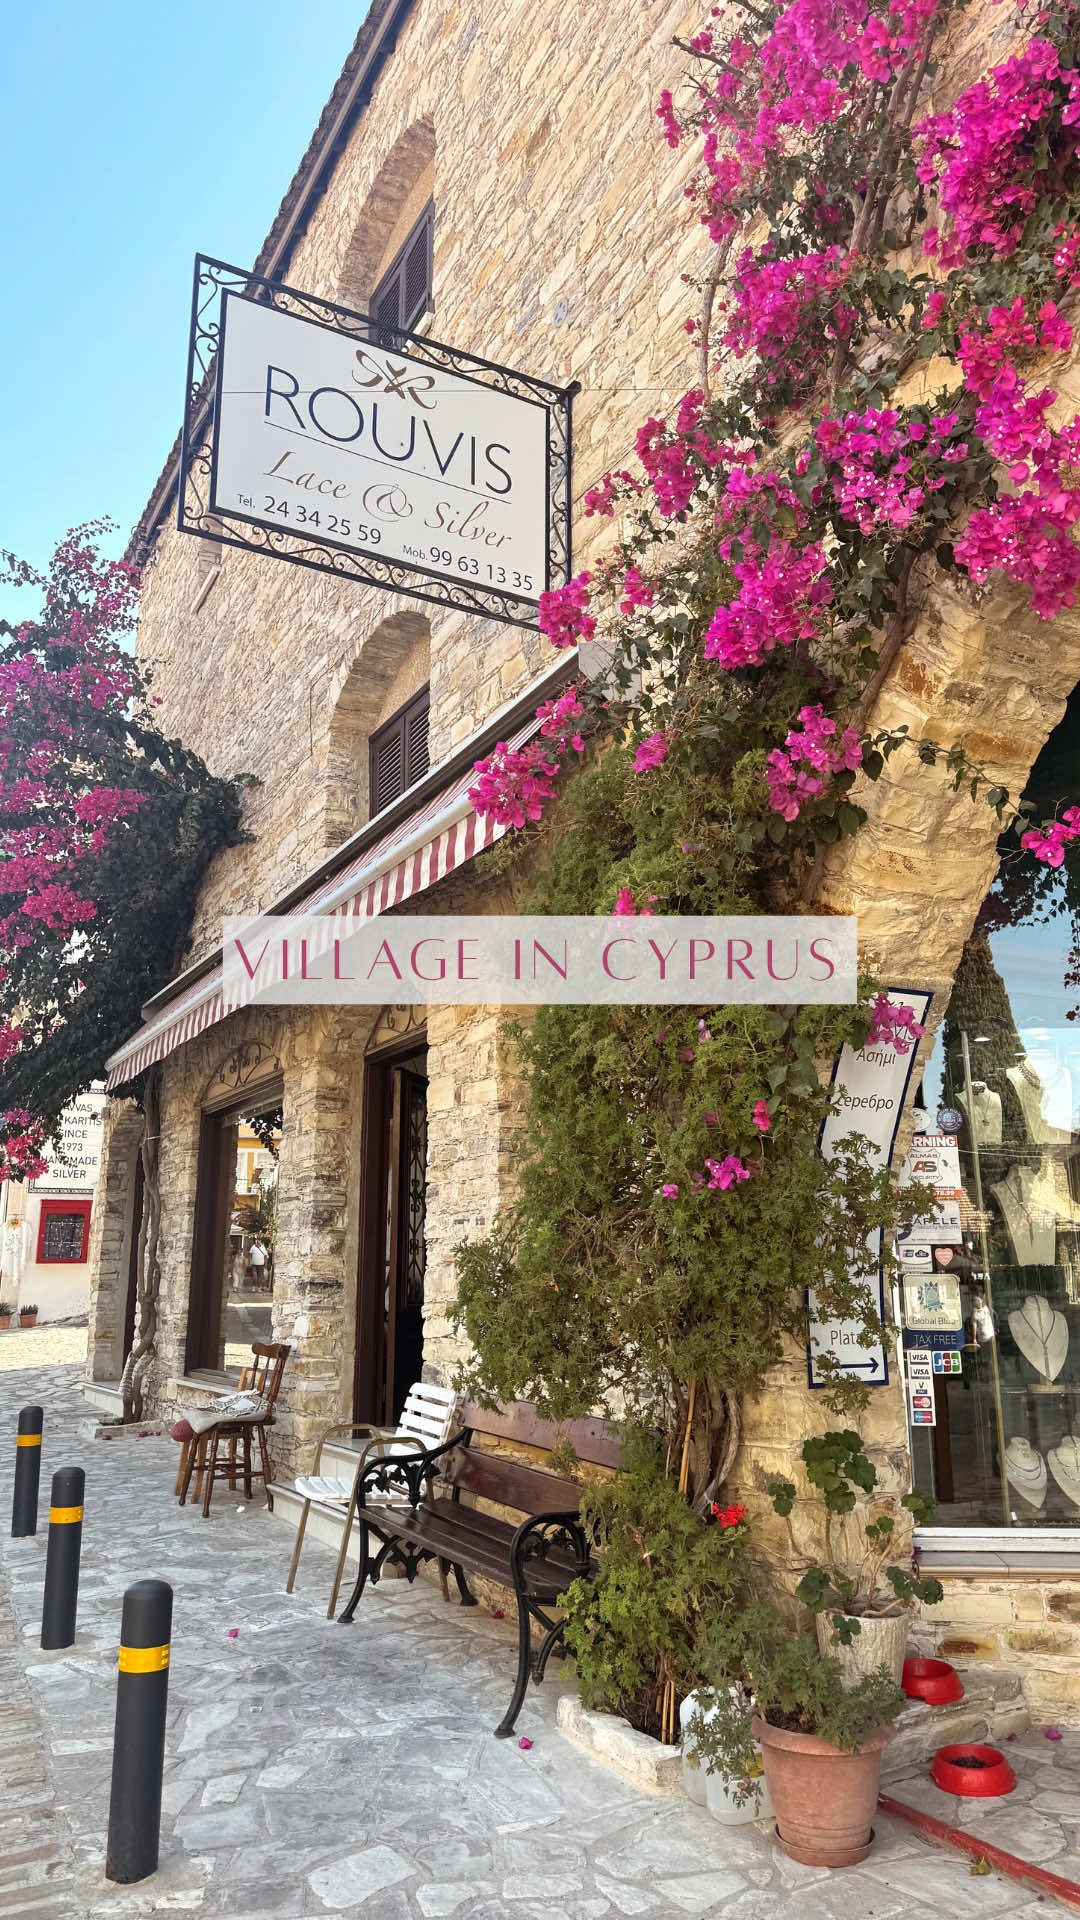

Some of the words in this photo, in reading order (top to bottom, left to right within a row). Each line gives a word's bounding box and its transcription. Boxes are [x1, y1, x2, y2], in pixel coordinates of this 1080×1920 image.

[264, 365, 512, 495] ROUVIS
[263, 450, 351, 499] Lace
[362, 481, 413, 523] &
[423, 501, 512, 548] Silver
[236, 493, 256, 509] Tel.
[263, 495, 290, 518] 24
[296, 505, 321, 527] 34
[327, 515, 351, 536] 25
[357, 524, 382, 544] 59
[402, 545, 428, 560] Mob.
[430, 546, 452, 566] 99
[457, 556, 479, 575] 63
[486, 564, 506, 583] 13
[512, 571, 533, 591] 35
[64, 1104, 93, 1112] AVVAS
[912, 1135, 956, 1147] RNING
[62, 1142, 83, 1152] 1973
[52, 1169, 87, 1179] SILVER
[912, 1316, 937, 1325] Global
[914, 1334, 932, 1344] TAX
[933, 1334, 957, 1345] FREE
[934, 1359, 960, 1367] JCB
